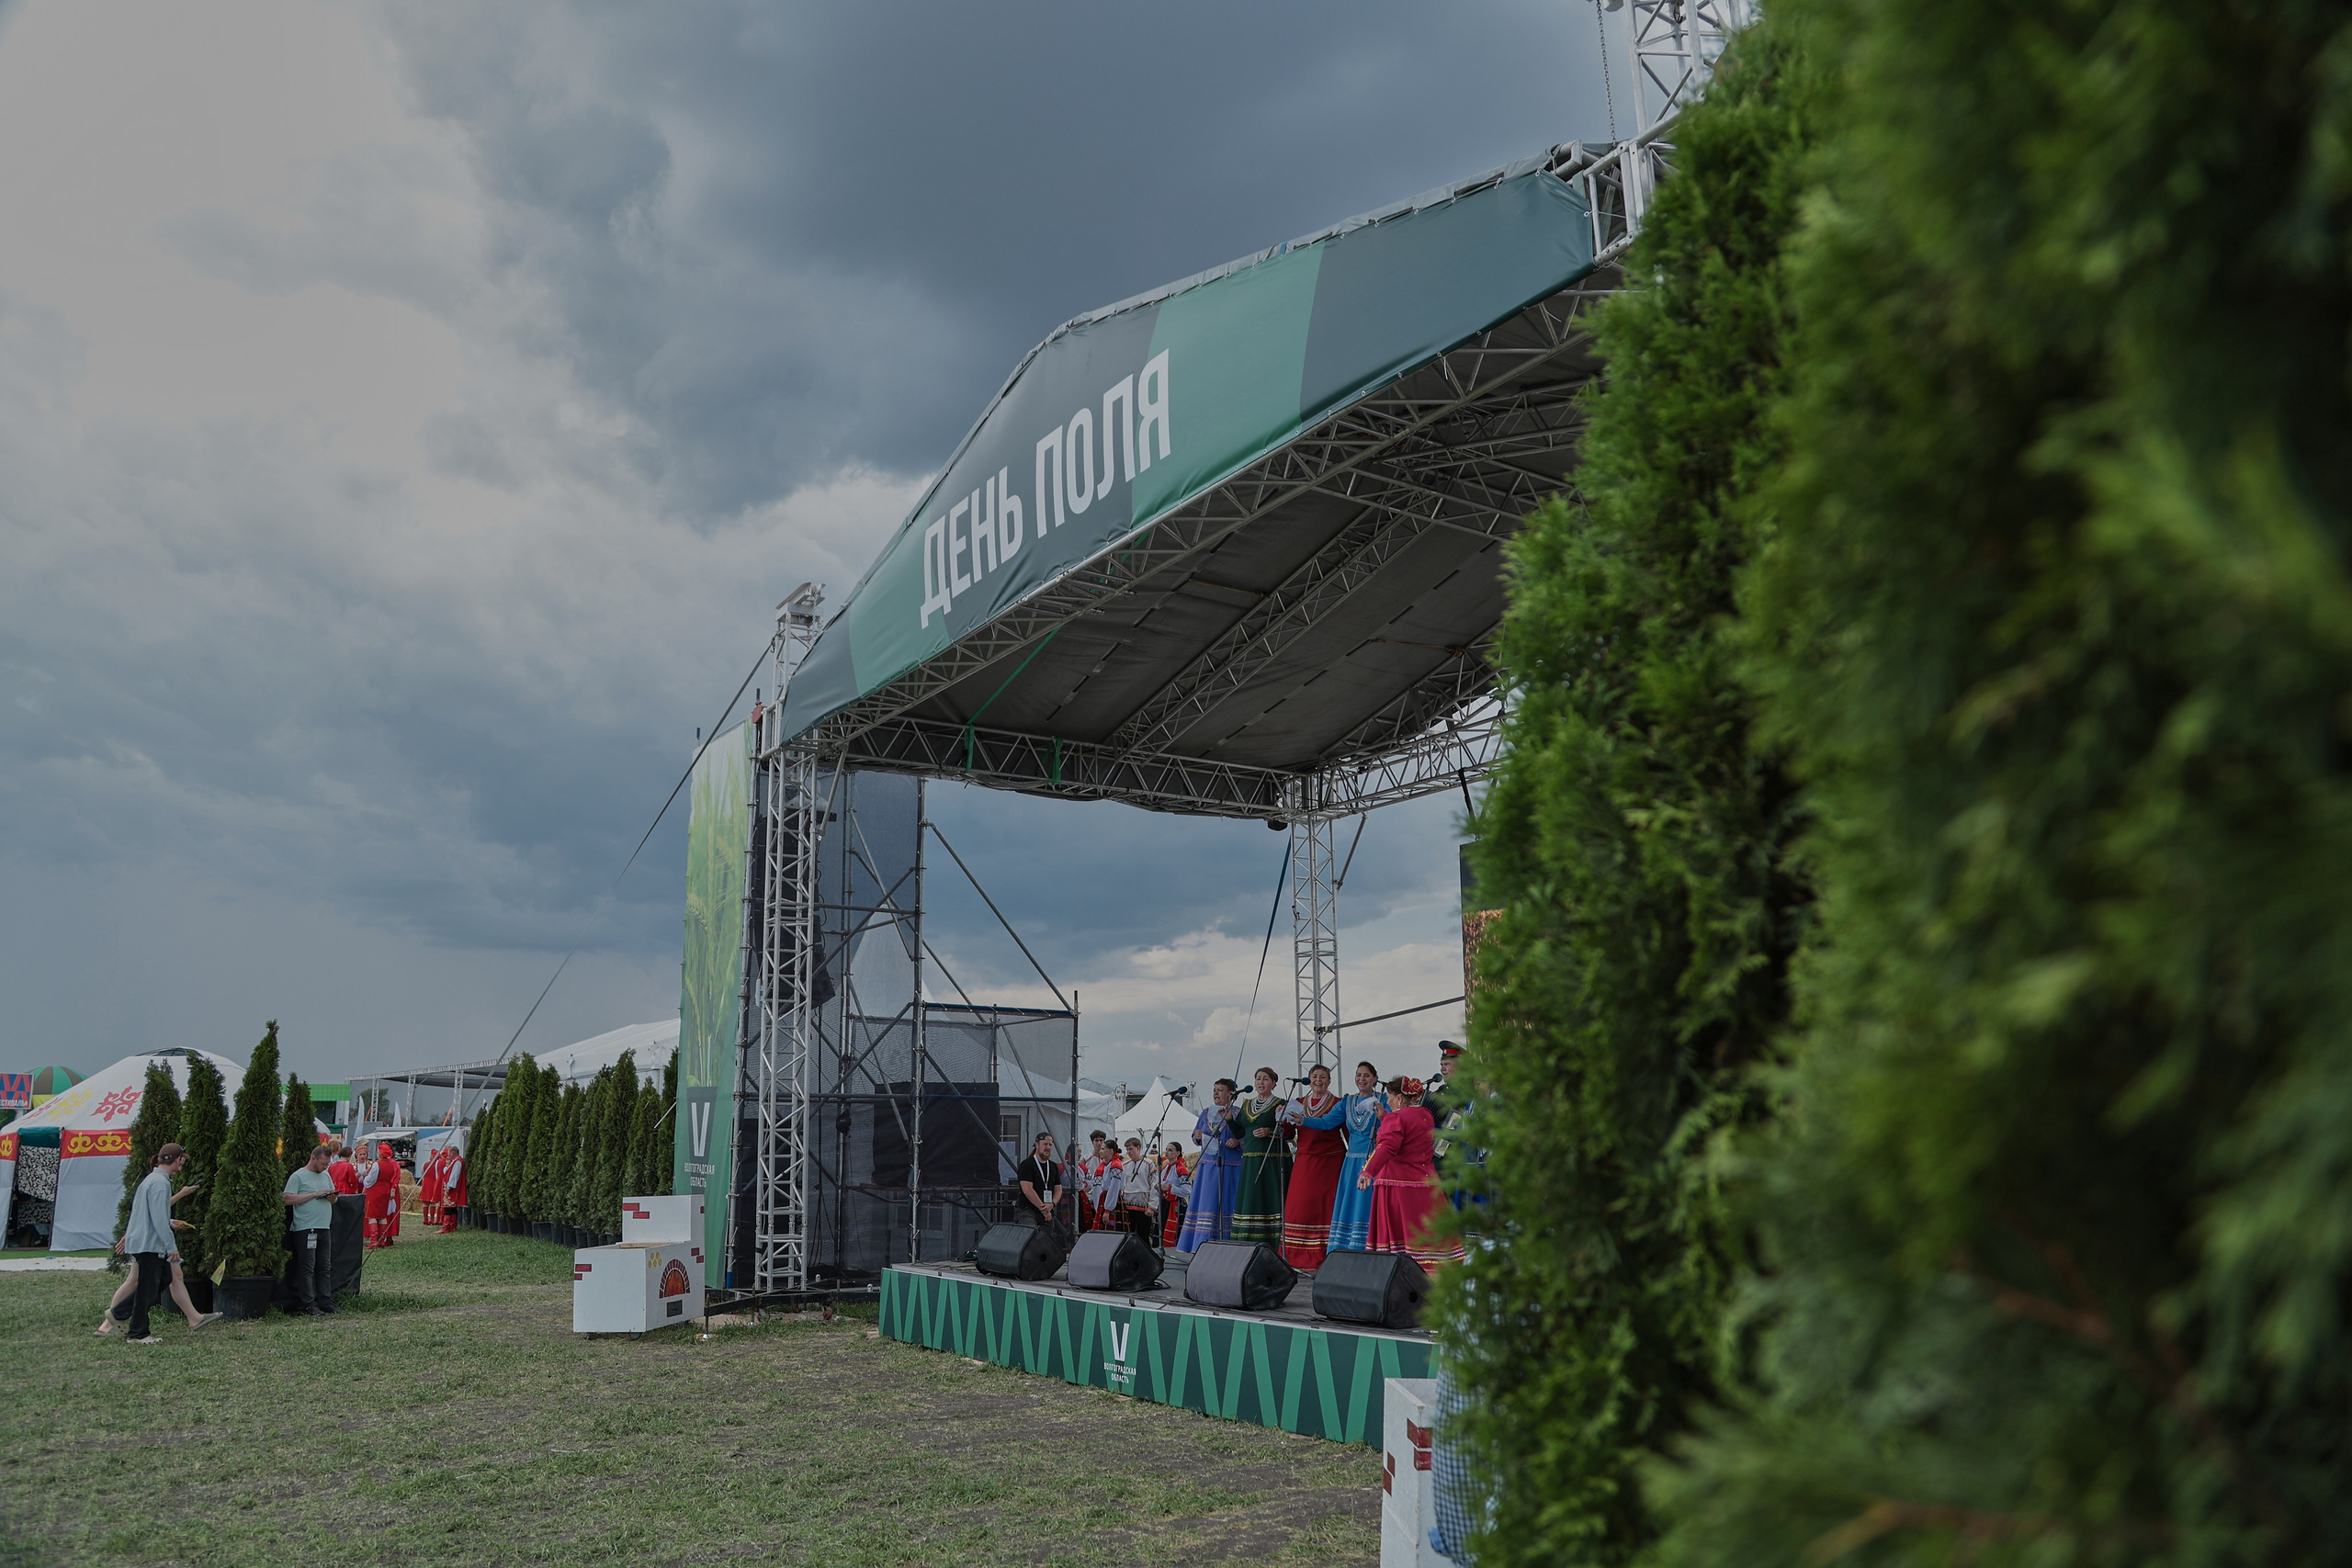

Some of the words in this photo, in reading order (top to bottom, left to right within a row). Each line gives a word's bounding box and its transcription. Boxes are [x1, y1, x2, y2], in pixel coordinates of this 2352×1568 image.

[920, 465, 1023, 630] ДЕНЬ
[1035, 347, 1171, 539] ПОЛЯ
[690, 1176, 707, 1188] ОБЛАСТЬ
[1103, 1361, 1136, 1376] ВОЛГОГРАДСКАЯ
[1110, 1372, 1130, 1384] ОБЛАСТЬ
